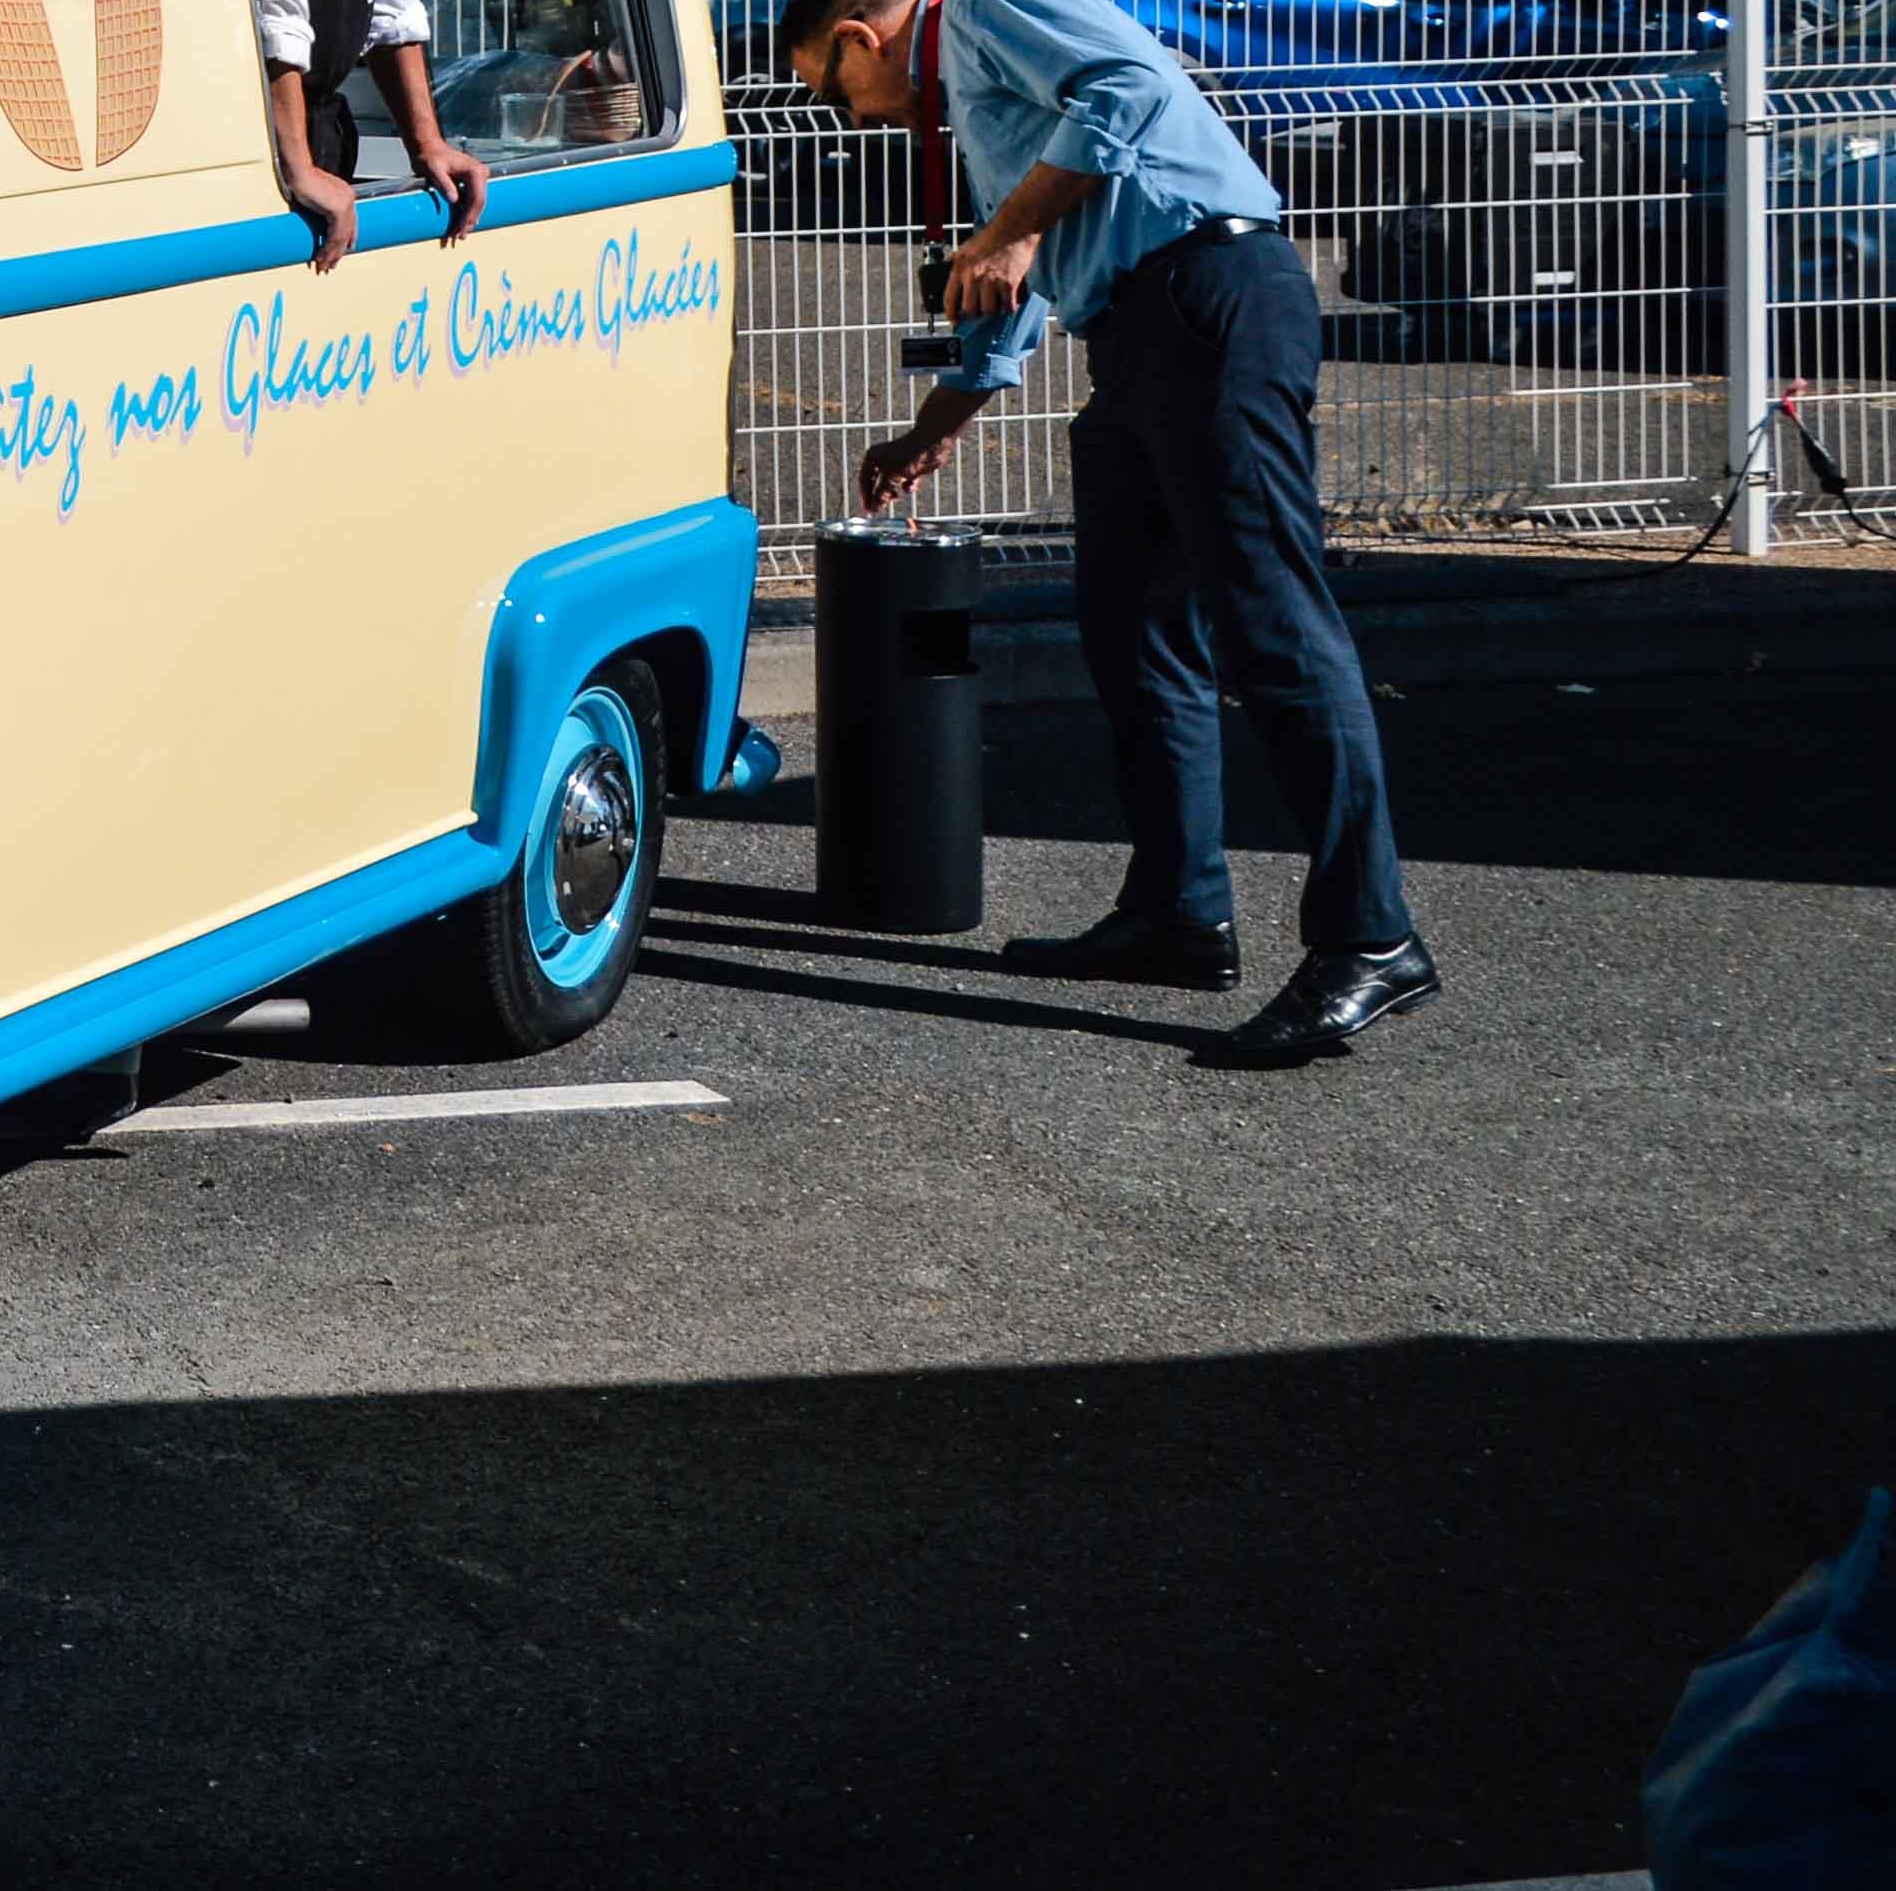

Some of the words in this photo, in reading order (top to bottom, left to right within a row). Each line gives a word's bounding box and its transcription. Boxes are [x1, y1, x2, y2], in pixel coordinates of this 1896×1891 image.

[109, 364, 201, 448] nos
[220, 290, 377, 454] Glaces
[391, 286, 432, 378] et
[447, 260, 587, 371] Crèmes
[593, 226, 723, 353] Glacées
